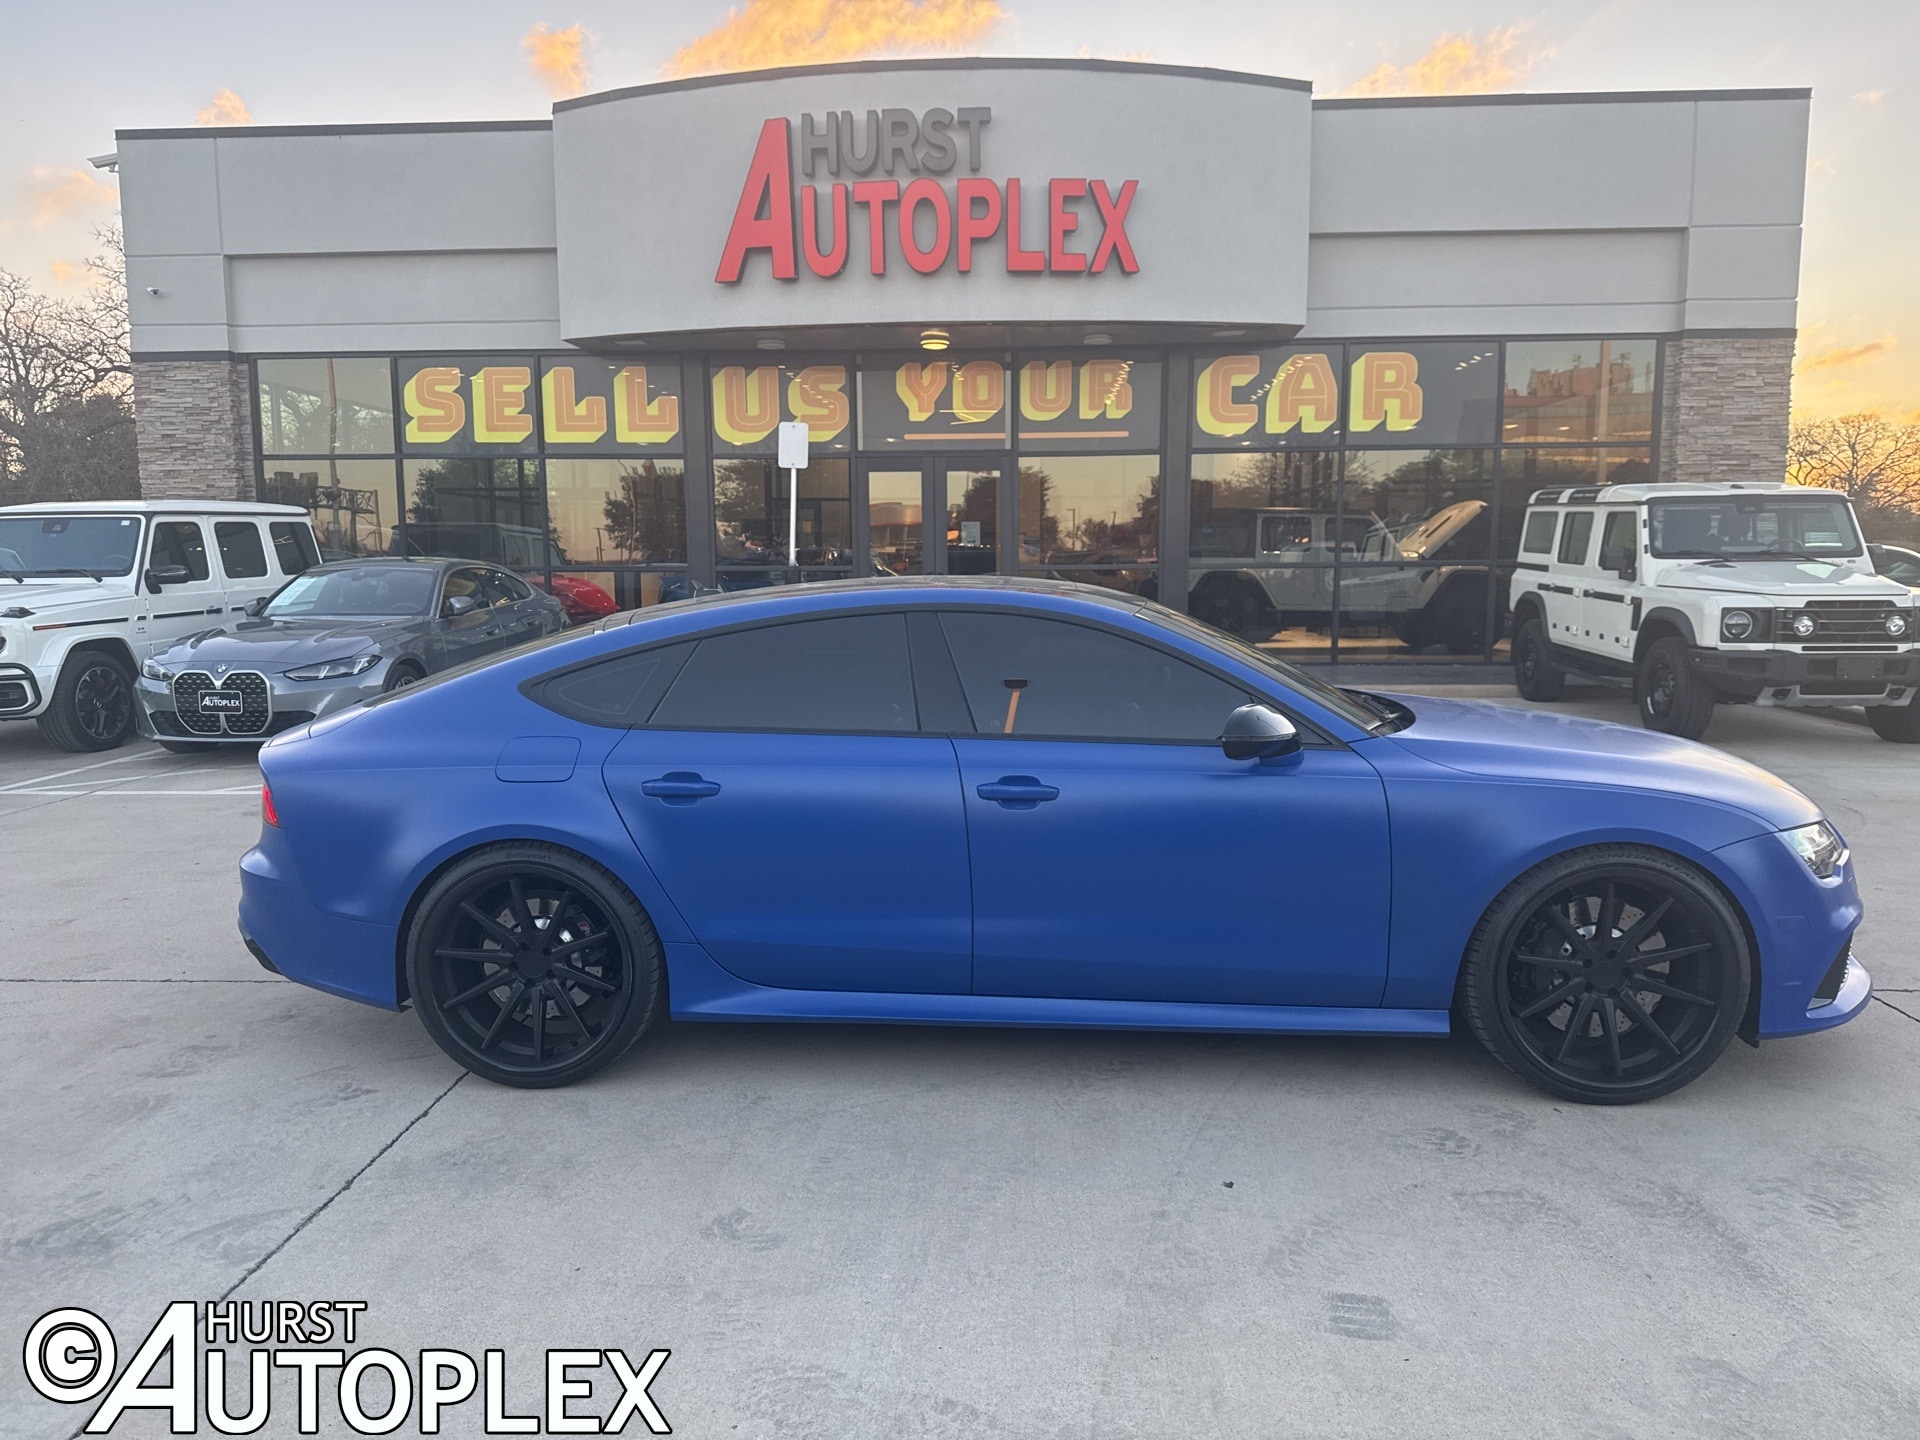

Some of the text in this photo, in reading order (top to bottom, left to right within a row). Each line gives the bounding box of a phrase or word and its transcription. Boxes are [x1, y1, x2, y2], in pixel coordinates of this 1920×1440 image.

[801, 106, 991, 177] HURST
[715, 116, 1140, 285] AUTOPLEX
[403, 351, 1424, 444] SELL US YOUR CAR
[201, 696, 240, 707] AUTOPLEX
